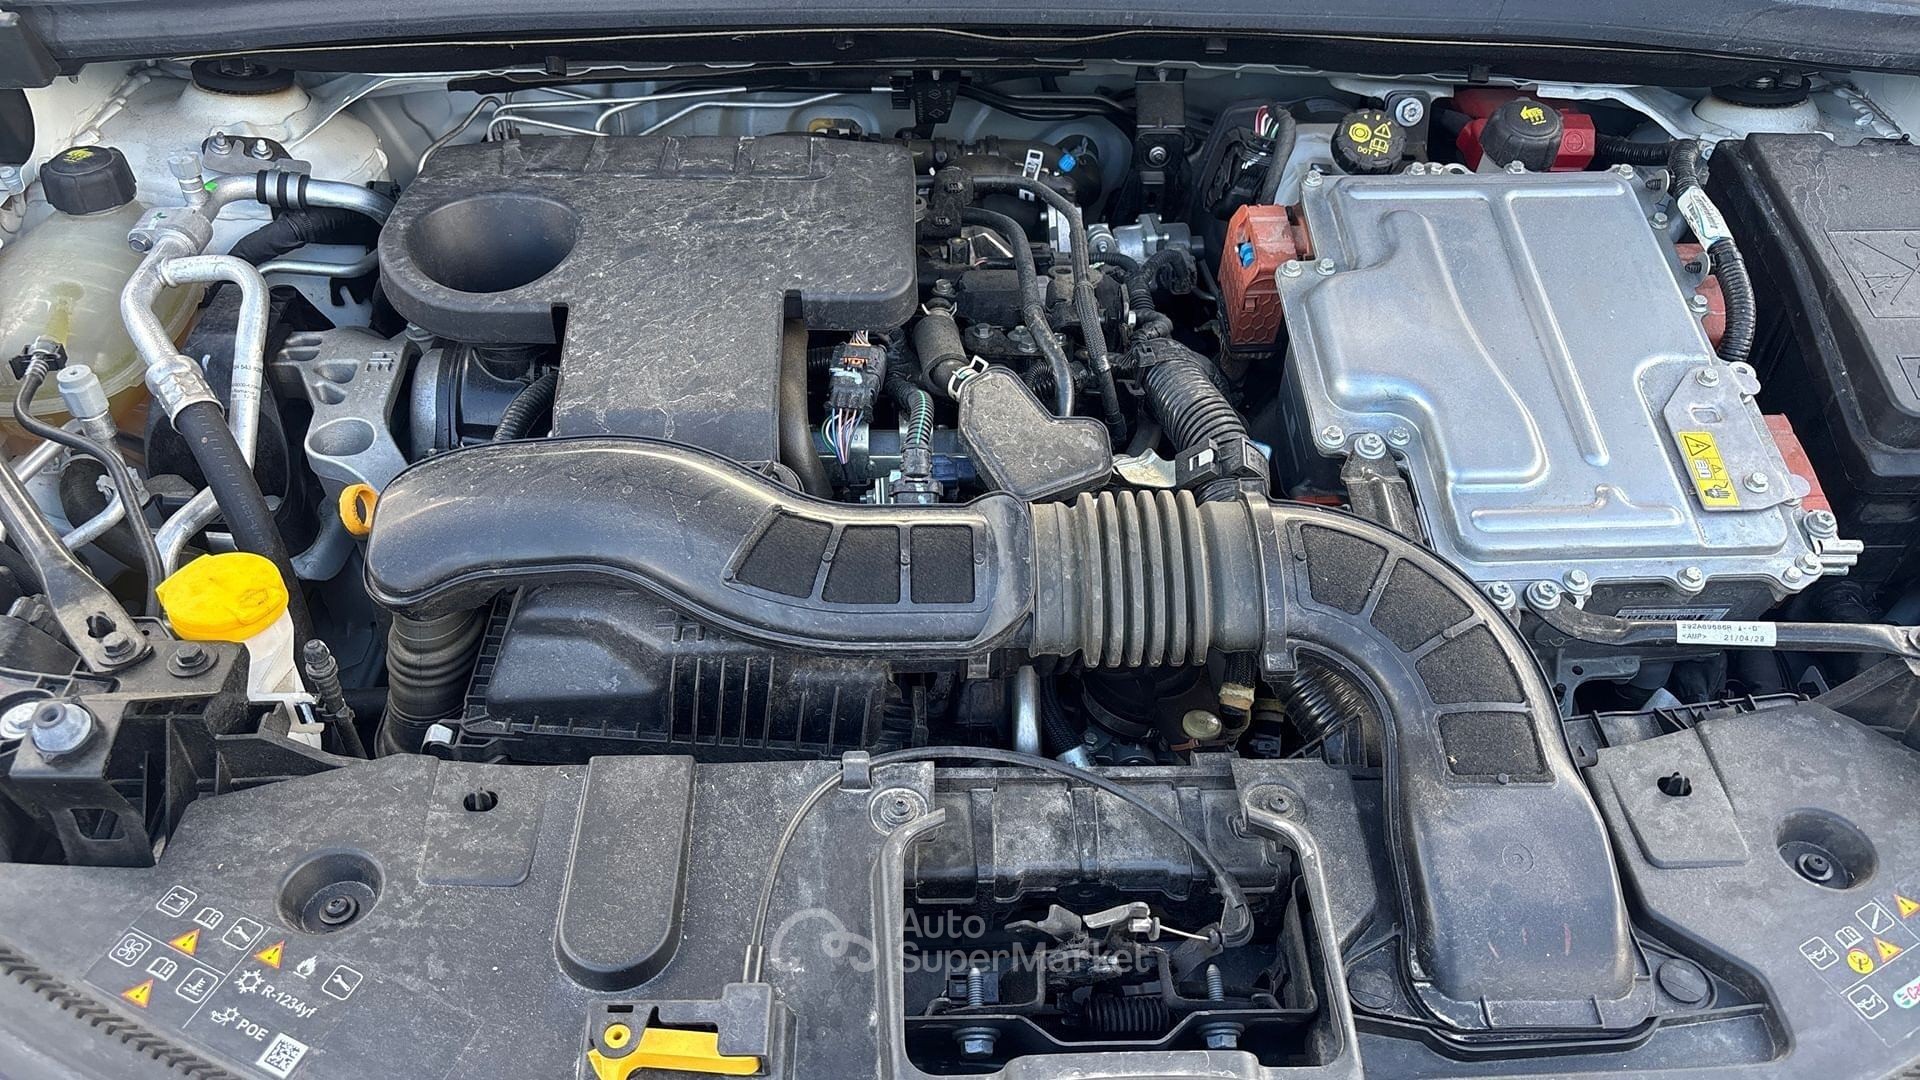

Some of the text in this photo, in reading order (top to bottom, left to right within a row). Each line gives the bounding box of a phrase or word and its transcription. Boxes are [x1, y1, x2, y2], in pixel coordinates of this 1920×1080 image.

[1357, 146, 1372, 155] DOT
[261, 984, 318, 1018] R-1234yf
[235, 1018, 269, 1041] POE
